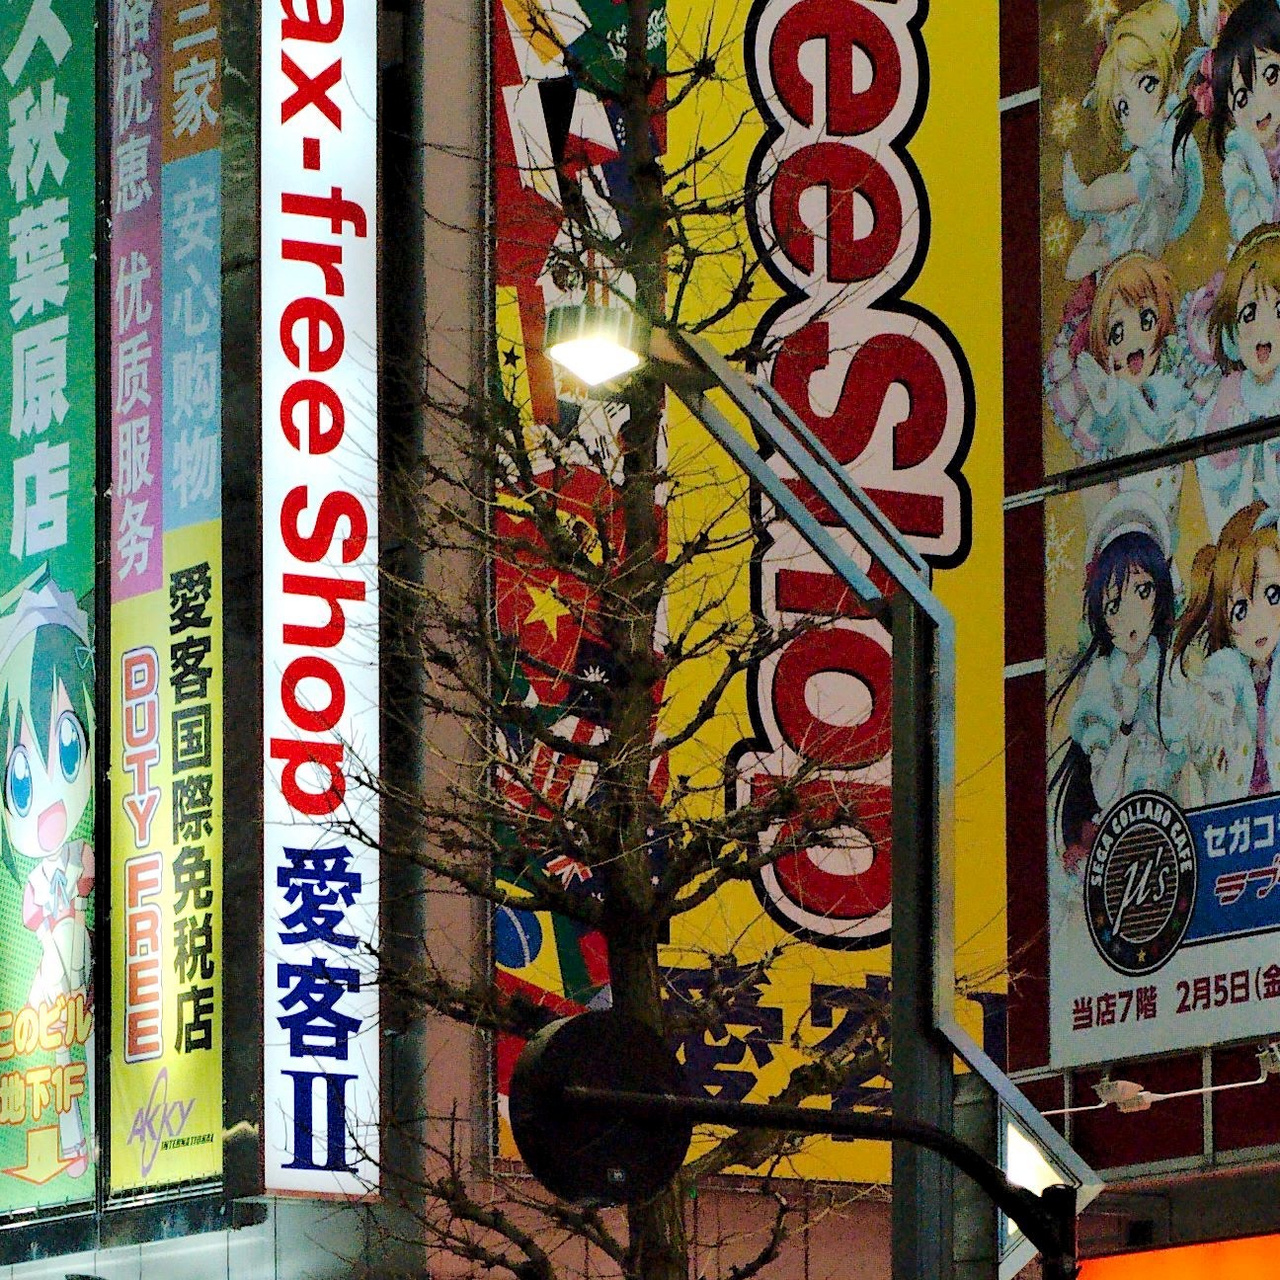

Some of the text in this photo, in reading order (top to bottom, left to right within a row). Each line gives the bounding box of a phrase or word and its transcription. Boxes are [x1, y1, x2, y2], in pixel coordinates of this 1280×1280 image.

[170, 178, 218, 508] 安心购物
[169, 562, 214, 1055] 愛客国際免税店
[270, 488, 368, 817] Shop
[121, 648, 163, 1062] DUTY FREE
[1072, 985, 1157, 1031] 当店7階
